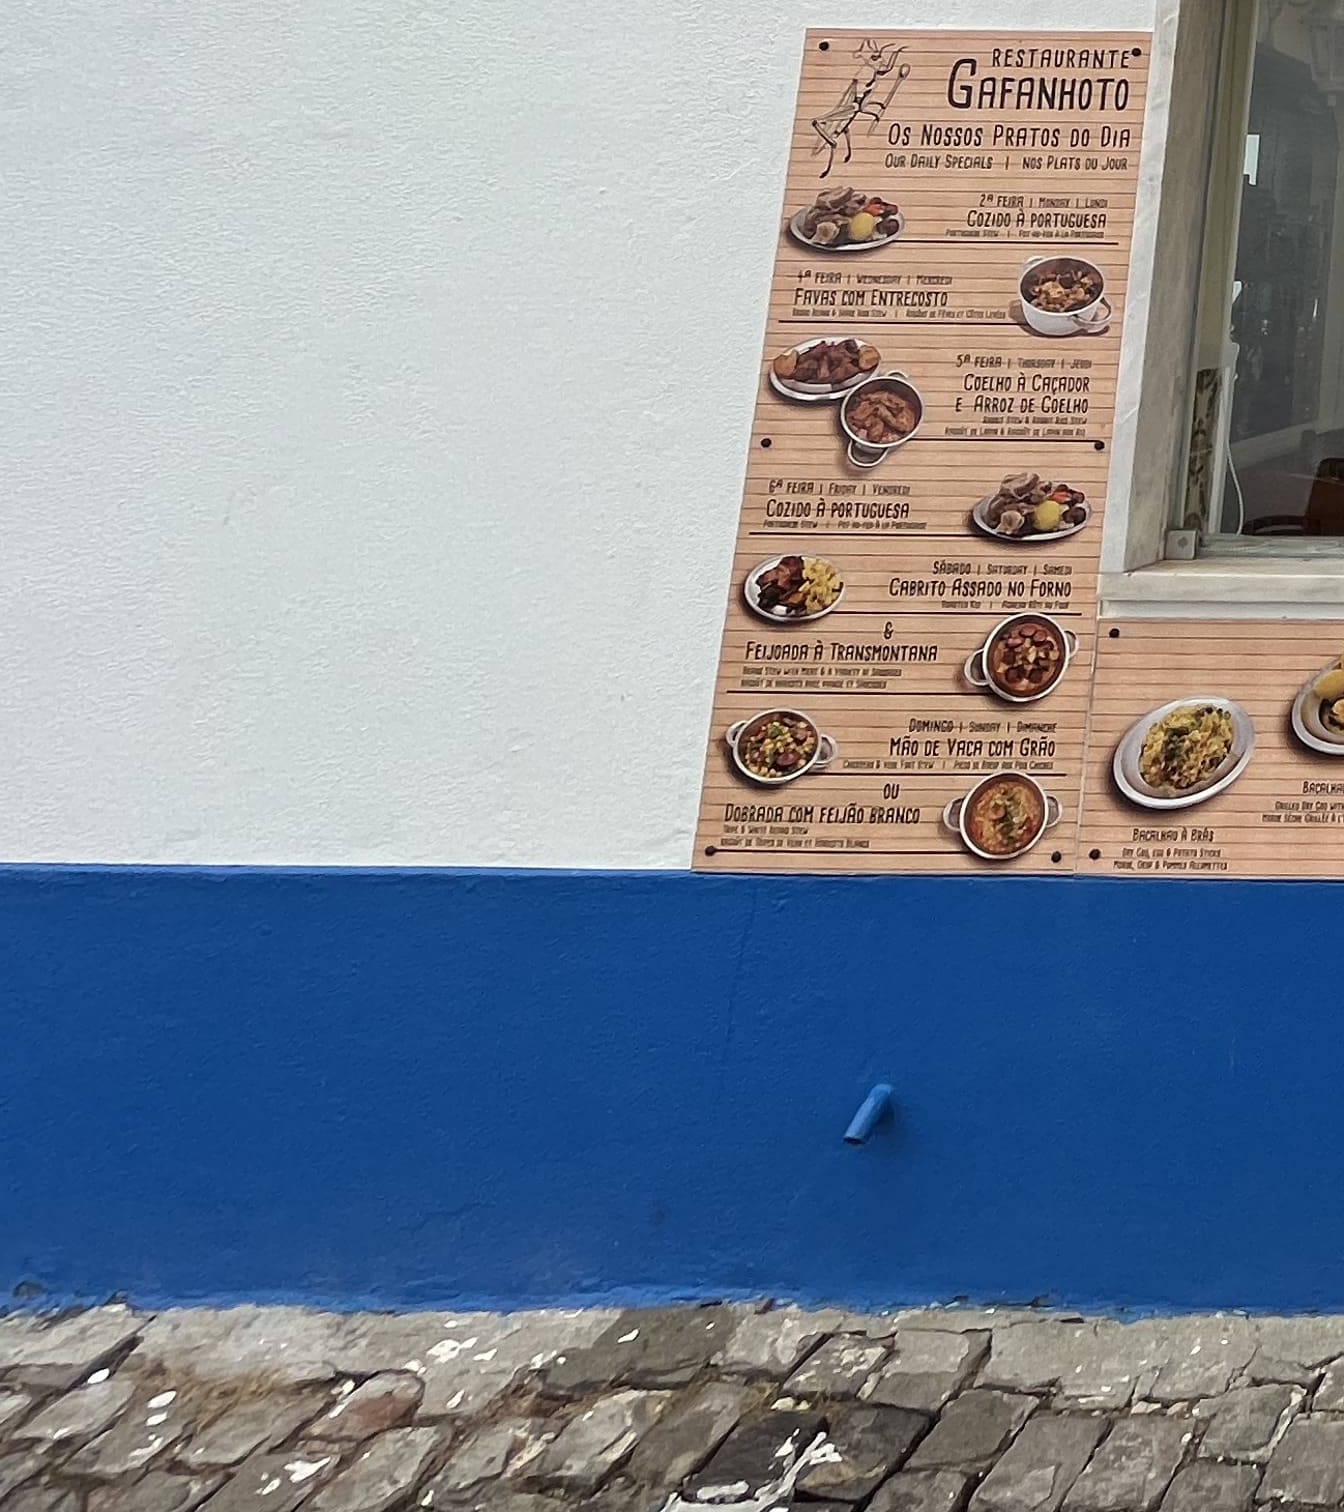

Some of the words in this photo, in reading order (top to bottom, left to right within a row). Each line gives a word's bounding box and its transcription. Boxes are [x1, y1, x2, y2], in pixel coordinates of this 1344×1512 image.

[992, 48, 1130, 68] RESTAURANTE
[948, 58, 1129, 111] GAFANHOTO
[888, 123, 911, 146] OS
[921, 124, 983, 147] NOSSOS
[993, 124, 1060, 147] PRATOS
[1070, 128, 1090, 147] DO
[1101, 126, 1130, 148] DIA
[885, 153, 908, 168] OUR
[910, 154, 941, 169] DAILY
[945, 154, 993, 169] SPECIALS
[1023, 156, 1043, 169] NOS
[1047, 155, 1081, 170] PLATS
[1102, 157, 1127, 170] JOUR
[997, 196, 1024, 208] FEIRA
[968, 210, 1011, 227] COZIDO
[1016, 209, 1025, 227] À
[1031, 213, 1107, 228] PORTUGUESA
[815, 273, 841, 284] FEIRA
[794, 288, 836, 305] FAVAS
[842, 290, 864, 305] COM
[871, 289, 947, 307] ENTRECOSTO
[975, 357, 1002, 368] FEIRA
[964, 374, 1012, 391] COELHO
[1017, 372, 1026, 392] À
[1032, 374, 1090, 395] CAÇADOR
[956, 397, 963, 412] E
[974, 395, 1014, 413] ARROZ
[1020, 397, 1035, 413] DE
[1041, 395, 1088, 413] COELHO
[787, 482, 814, 494] FEIRA
[767, 499, 811, 517] COZIDO
[816, 498, 825, 517] À
[831, 502, 910, 518] PORTUGUESA
[933, 560, 971, 574] SÁBADO
[890, 578, 945, 596] CABRITO
[952, 578, 1001, 597] ASSADO
[1008, 581, 1024, 597] NO
[1030, 579, 1071, 597] FORNO
[884, 622, 893, 639] &
[745, 641, 808, 660] FEIJOADA
[814, 640, 823, 660] À
[831, 643, 937, 661] TRANSMONTANA
[909, 719, 954, 732] DOMINGO
[890, 736, 919, 756] MÃO
[925, 740, 940, 756] DE
[948, 739, 982, 756] VACA
[988, 740, 1014, 756] COM
[1020, 736, 1055, 756] GRÃO
[883, 784, 899, 799] OU
[724, 803, 783, 822] DOBRADA
[788, 806, 814, 823] COM
[819, 803, 864, 824] FEIJÃO
[870, 807, 920, 824] BRANCO
[1132, 828, 1178, 842] BACALHAU
